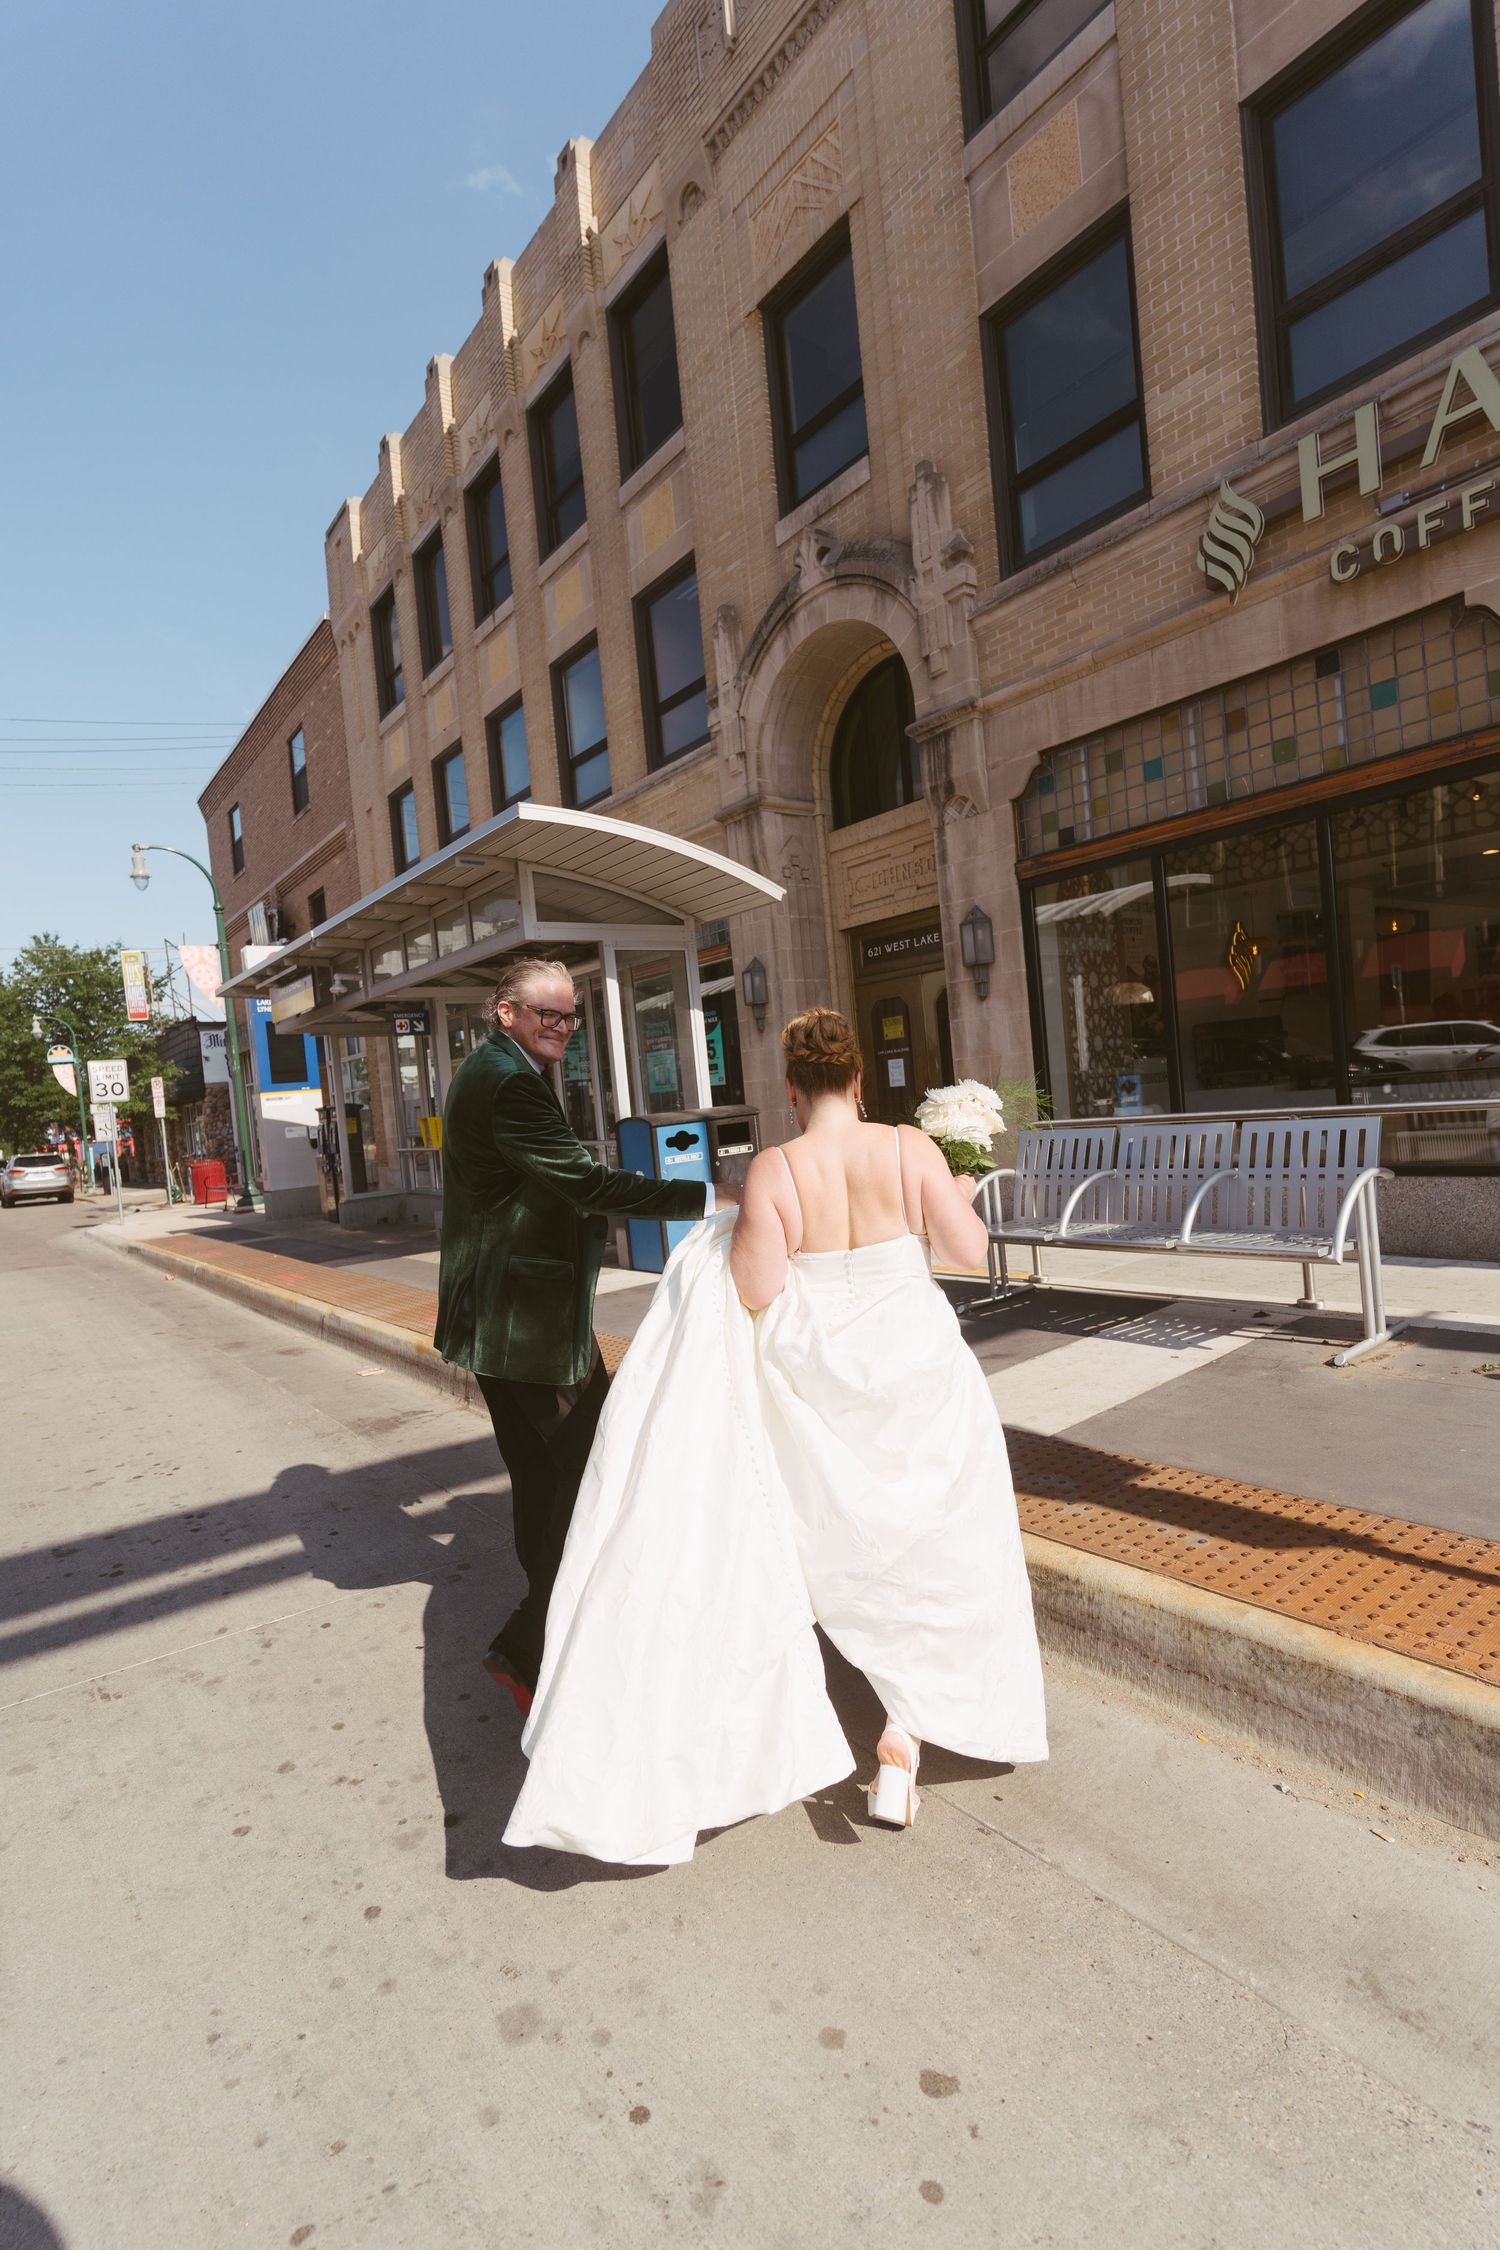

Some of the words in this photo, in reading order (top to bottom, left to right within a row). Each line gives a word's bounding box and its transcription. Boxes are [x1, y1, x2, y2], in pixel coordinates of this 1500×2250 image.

[1330, 479, 1495, 583] COFF
[867, 946, 882, 958] 621
[884, 939, 911, 953] WEST
[913, 932, 940, 947] LAKE
[92, 1064, 123, 1073] SPEED
[96, 1073, 120, 1081] LIMIT
[96, 1082, 124, 1097] 30
